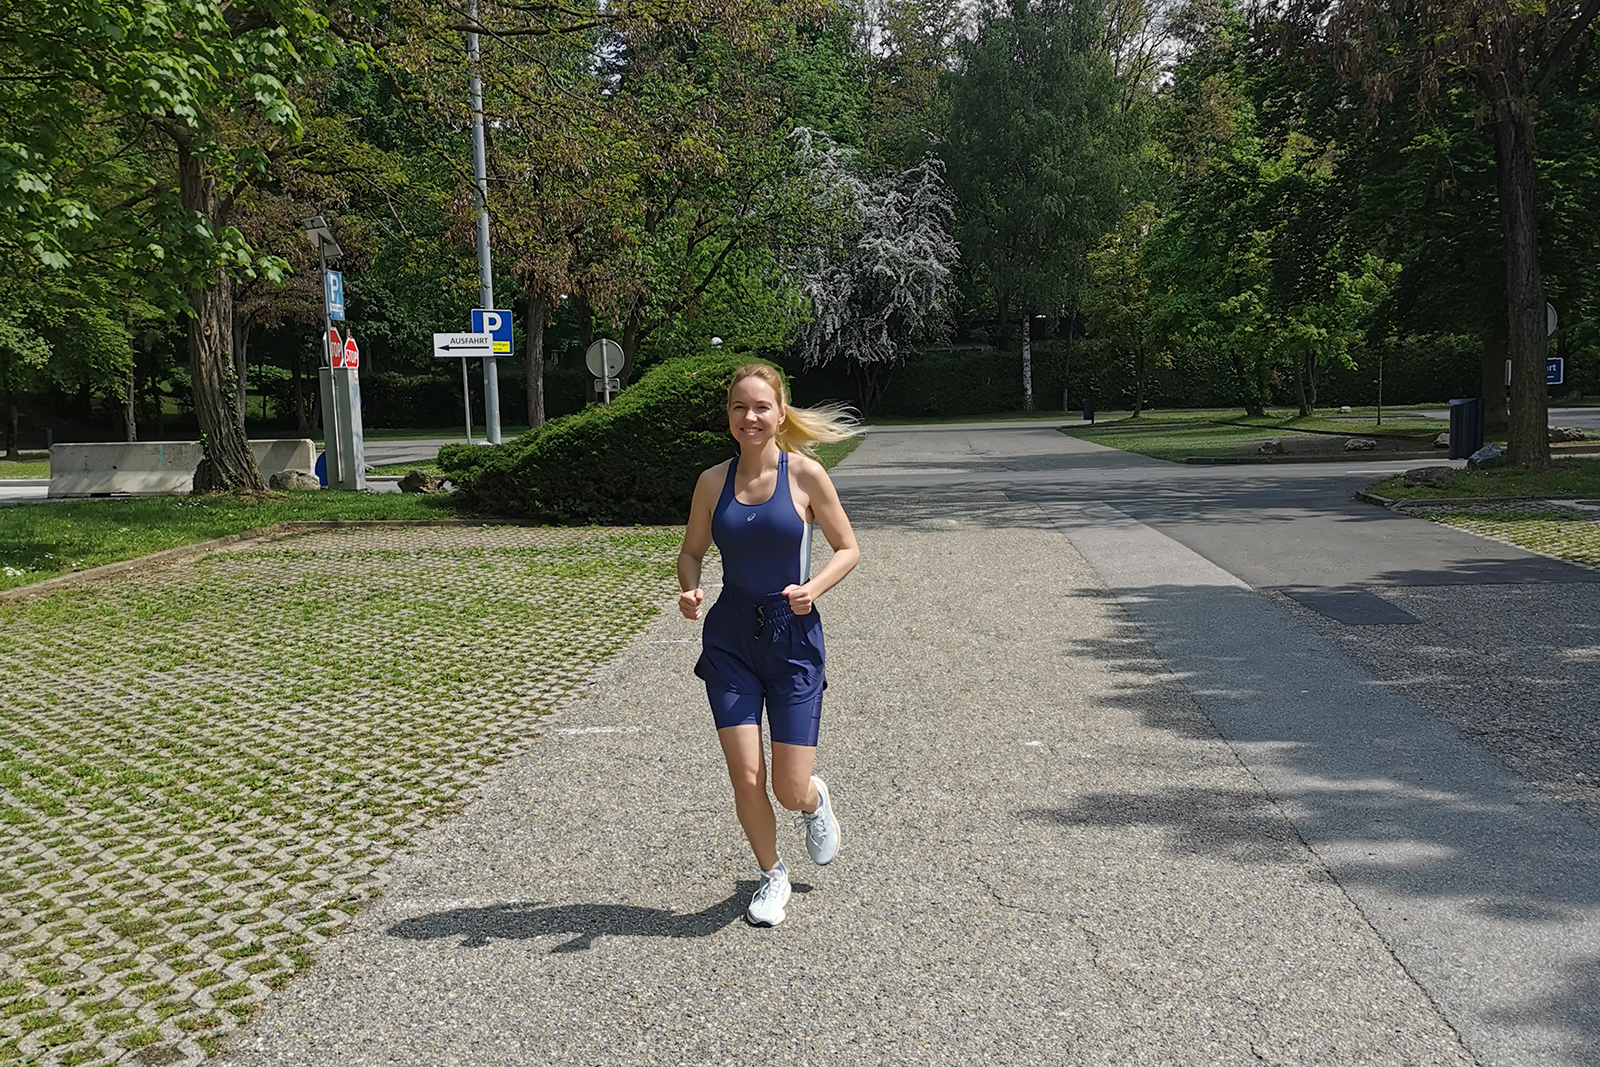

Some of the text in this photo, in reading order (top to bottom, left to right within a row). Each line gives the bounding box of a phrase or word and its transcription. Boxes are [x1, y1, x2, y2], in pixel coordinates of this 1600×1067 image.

[483, 312, 502, 334] P
[450, 337, 489, 345] AUSFAHRT
[331, 341, 341, 358] TOP
[345, 348, 358, 364] STOP
